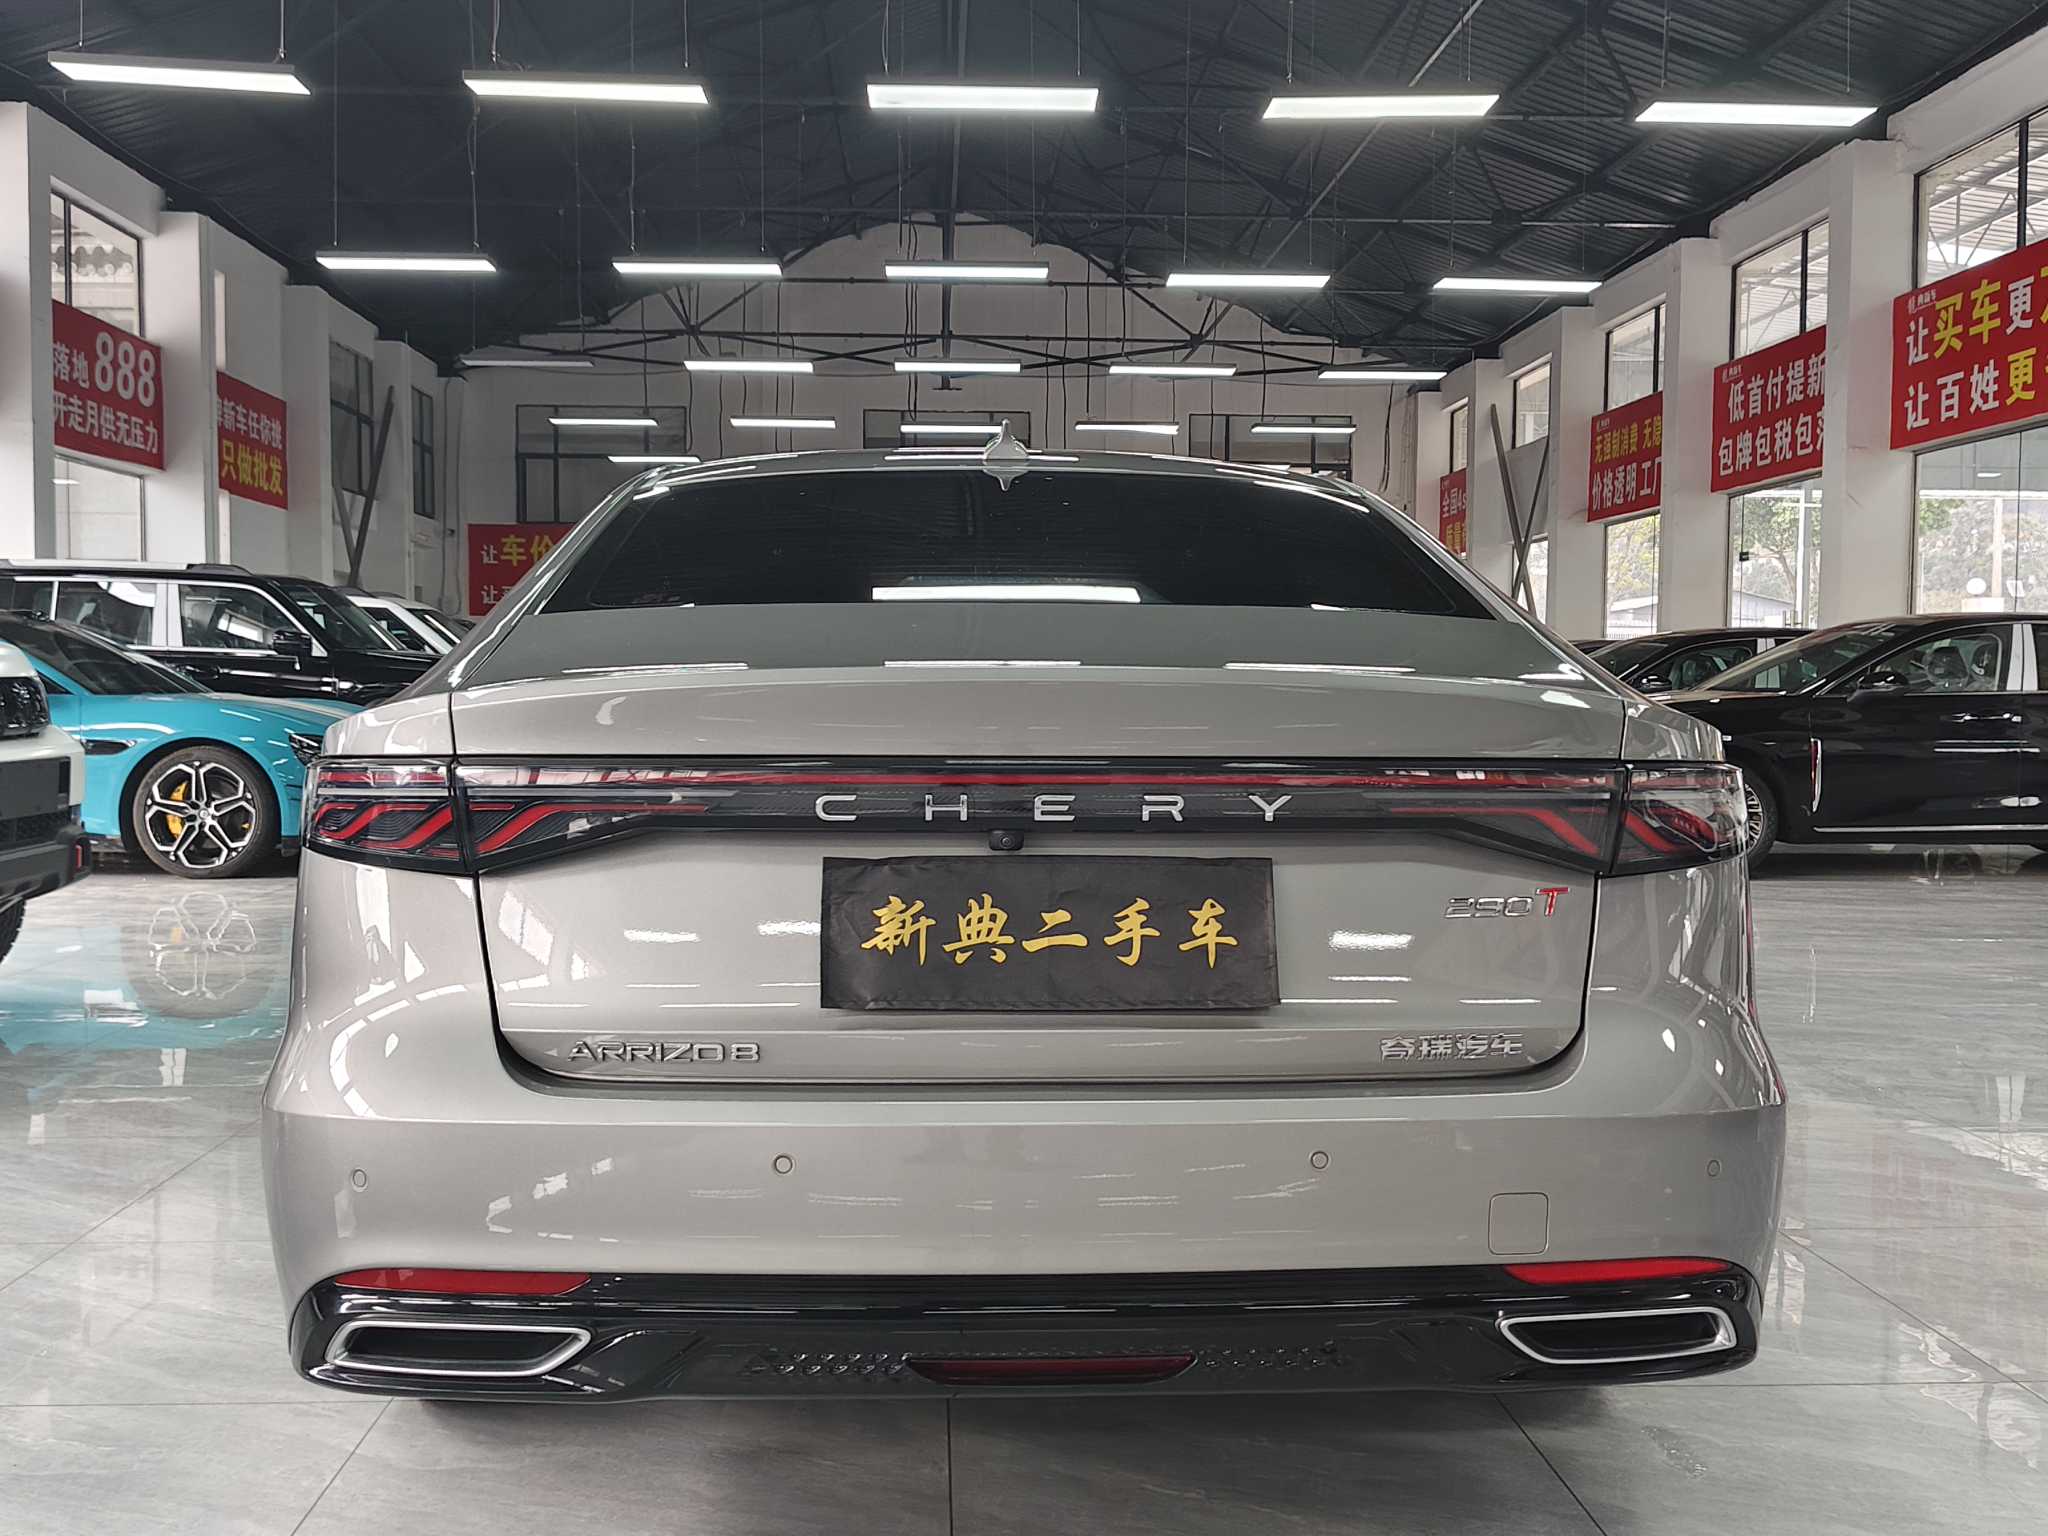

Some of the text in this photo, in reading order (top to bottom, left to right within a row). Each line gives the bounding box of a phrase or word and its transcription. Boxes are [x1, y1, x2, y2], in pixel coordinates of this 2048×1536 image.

[1906, 266, 2048, 366] 让买车更
[1904, 347, 2048, 431] 让百姓更
[221, 440, 283, 496] 只做批发
[1592, 462, 1637, 512] 价格透明
[480, 585, 512, 604] 让
[815, 794, 1292, 822] CHERY
[861, 892, 1239, 969] 新典二手车
[1379, 1032, 1524, 1063] 奇瑞汽车
